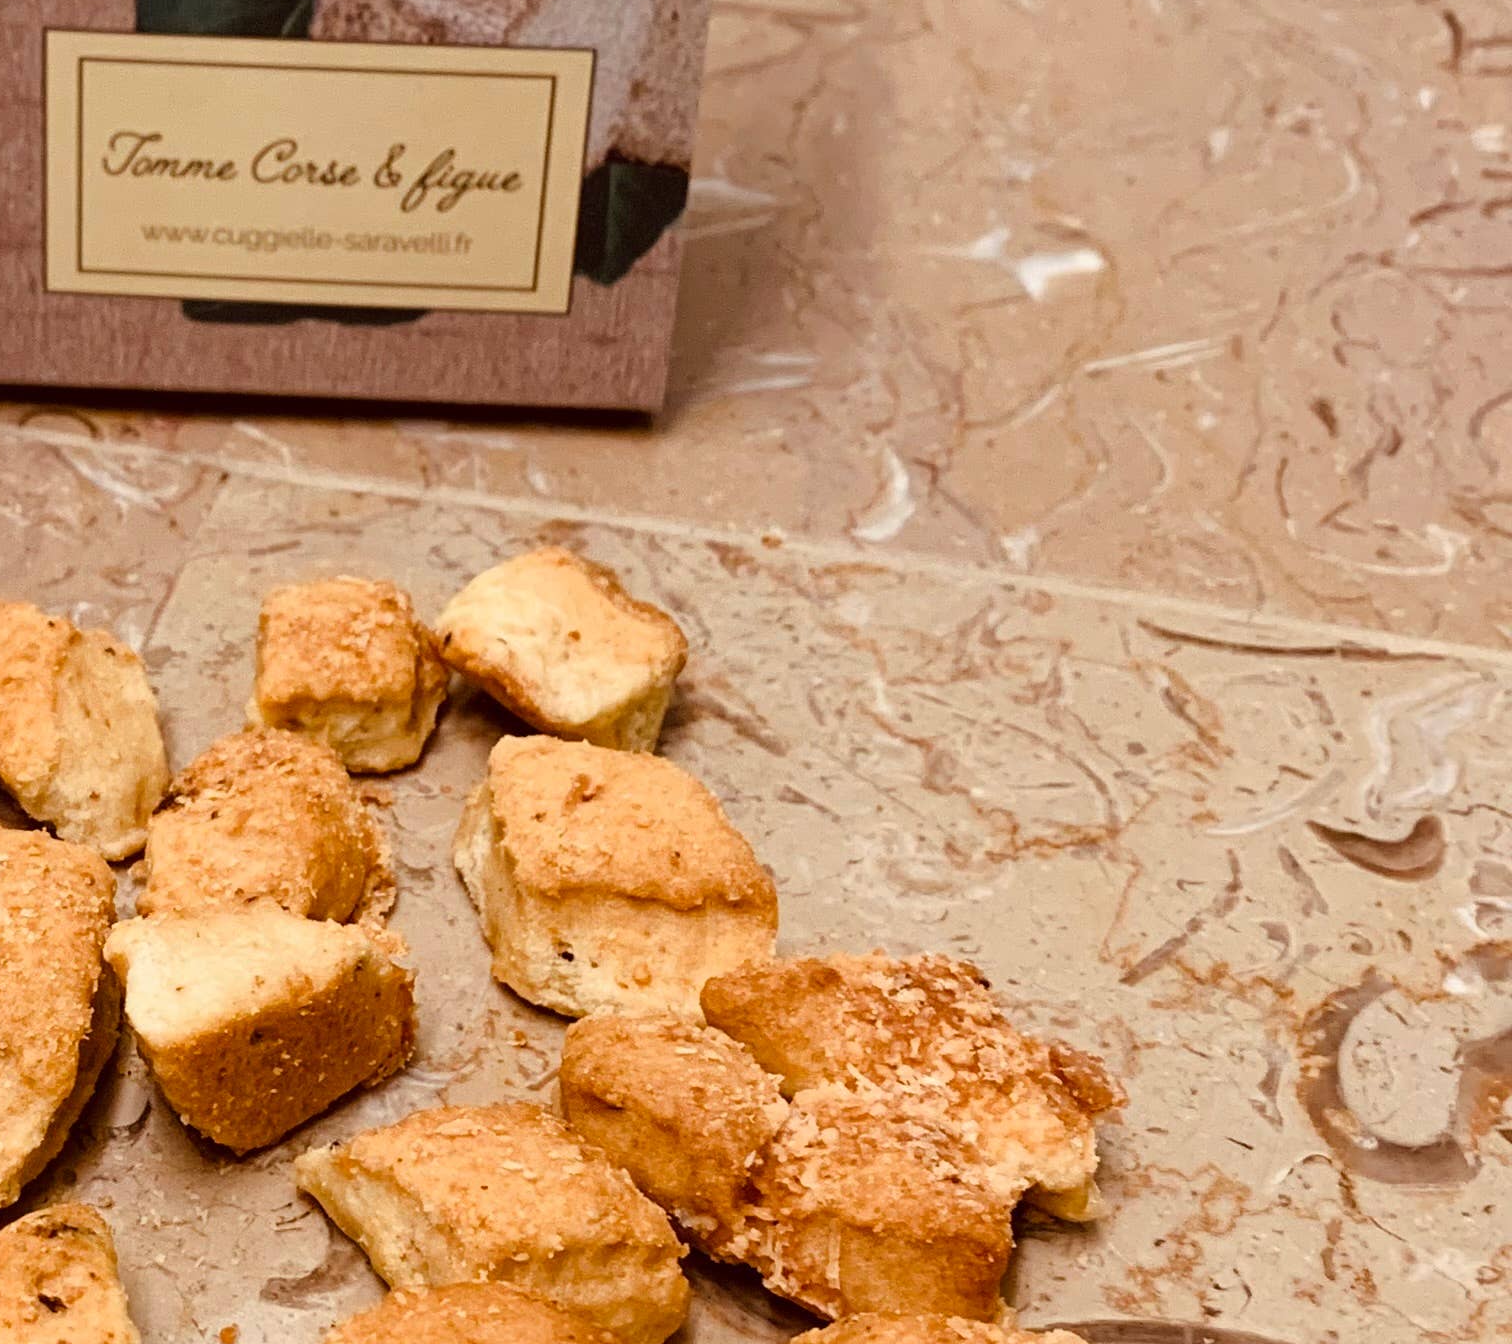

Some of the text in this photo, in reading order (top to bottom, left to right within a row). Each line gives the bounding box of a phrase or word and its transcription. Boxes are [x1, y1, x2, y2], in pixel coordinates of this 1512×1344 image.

[102, 130, 524, 215] Tomme Corse & figue
